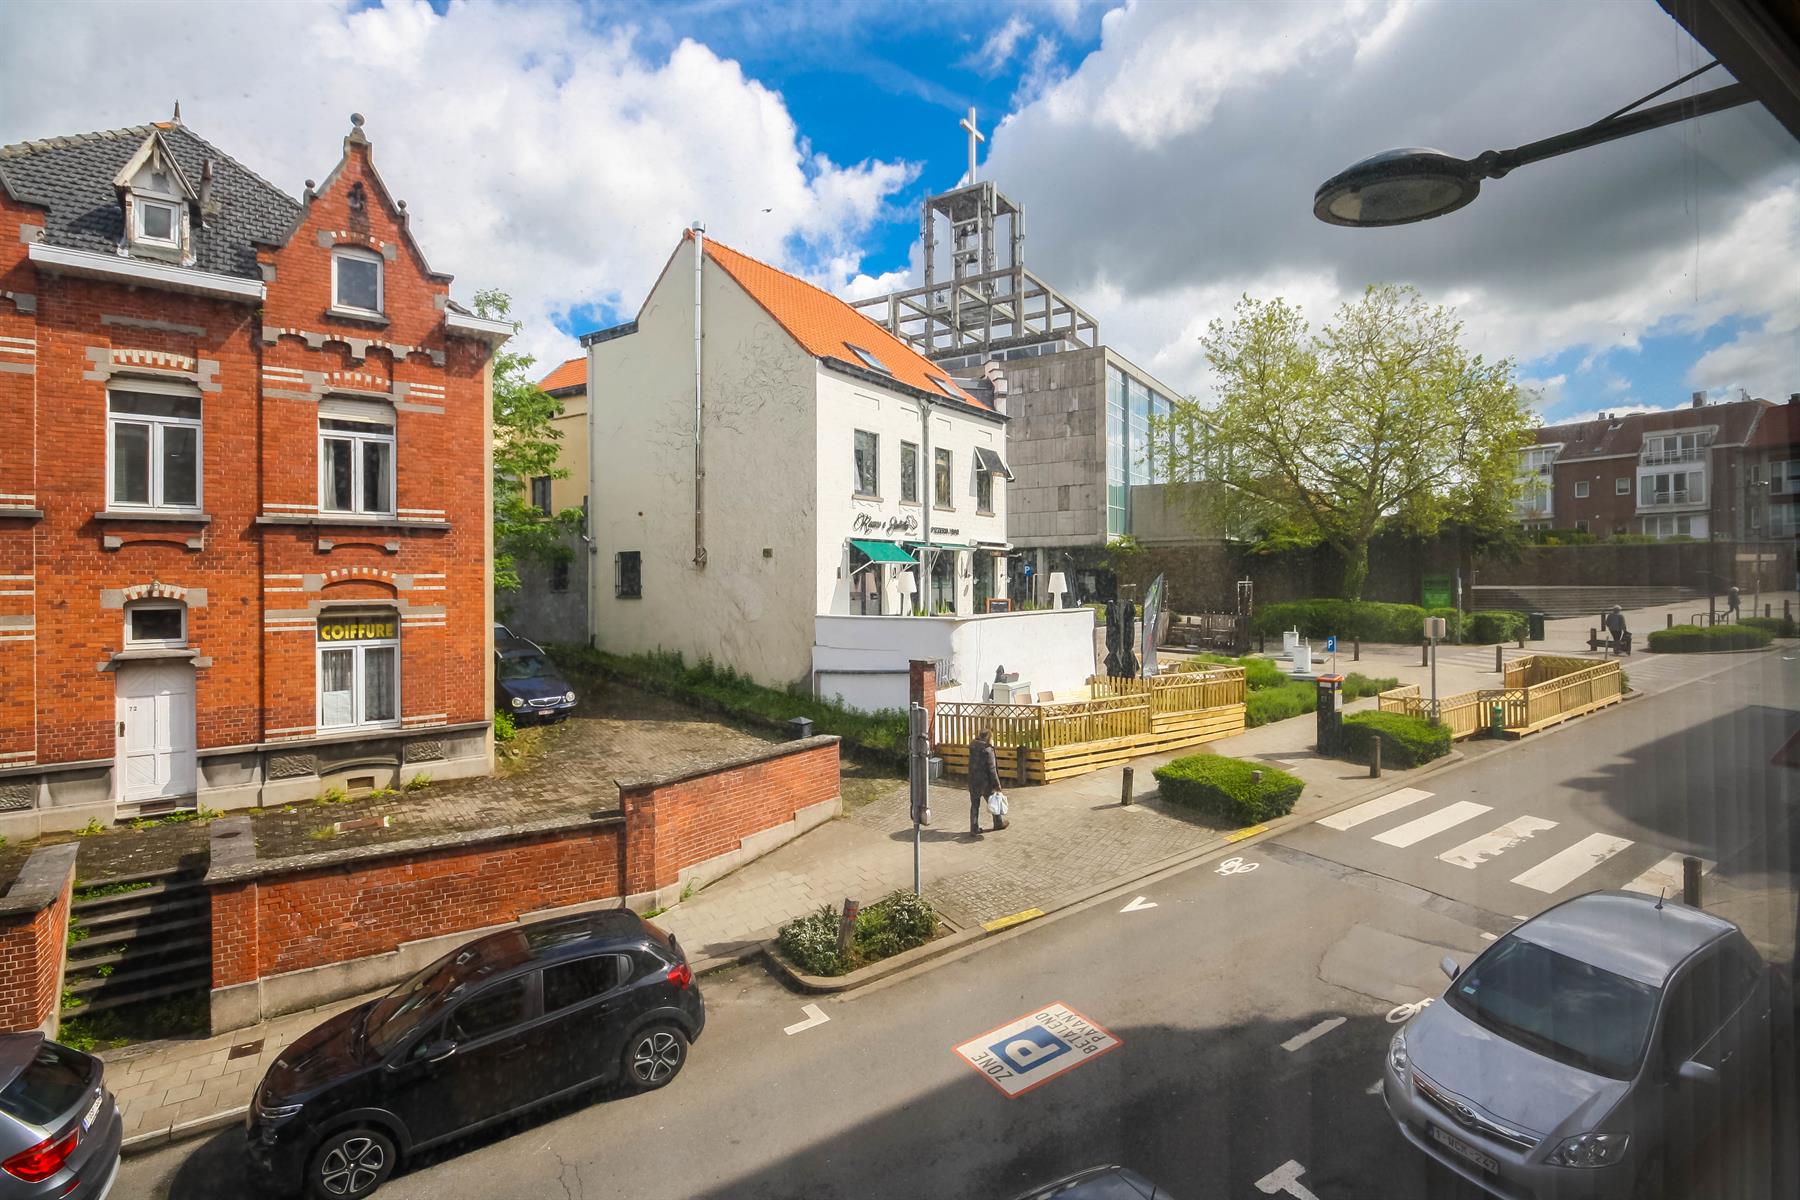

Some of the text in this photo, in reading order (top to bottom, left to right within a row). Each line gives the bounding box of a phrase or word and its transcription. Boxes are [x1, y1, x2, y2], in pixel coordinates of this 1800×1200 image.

[1024, 565, 1030, 574] P
[321, 623, 394, 640] COIFFURE
[1035, 1012, 1098, 1054] BETALEND
[1054, 1010, 1106, 1041] PAYANT
[971, 1051, 1014, 1082] ZONE
[1005, 1039, 1061, 1067] P
